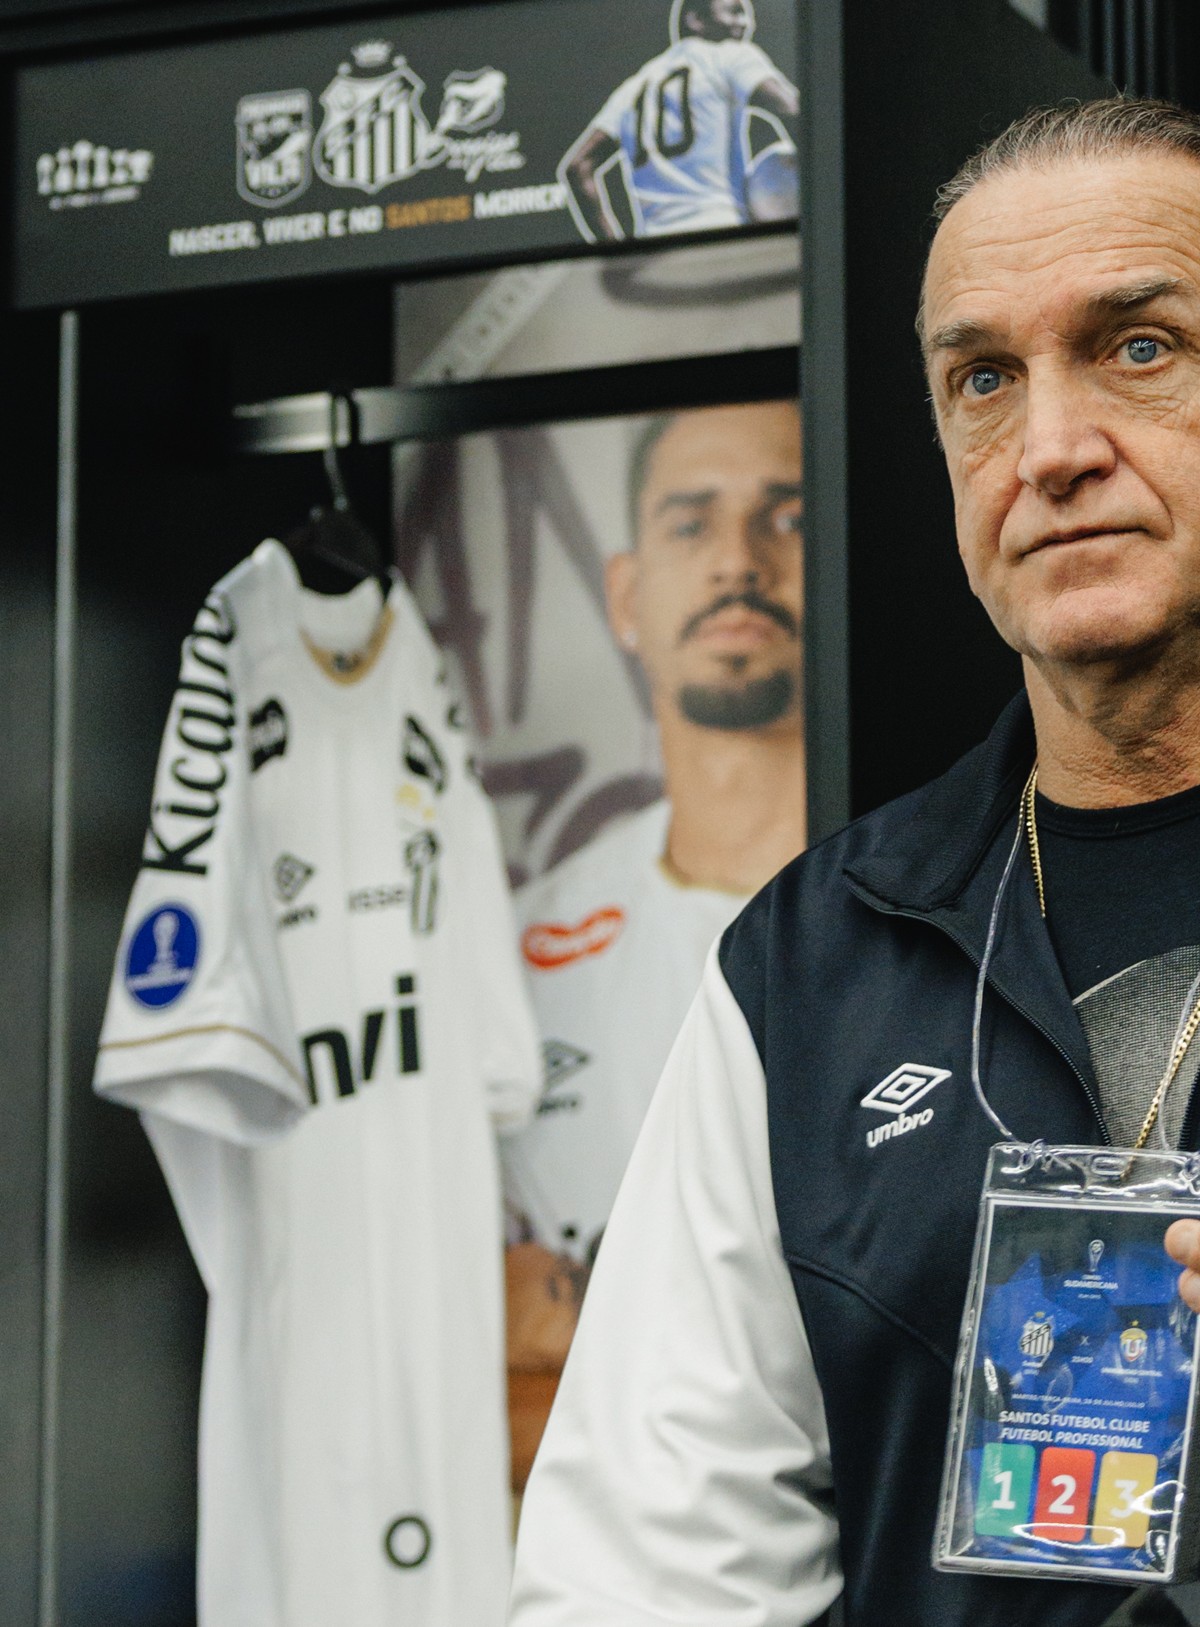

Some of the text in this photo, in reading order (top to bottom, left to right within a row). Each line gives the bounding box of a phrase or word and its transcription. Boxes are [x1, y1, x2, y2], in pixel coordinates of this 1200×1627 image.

[633, 66, 696, 170] 10
[168, 220, 260, 256] NASCER,
[262, 211, 326, 245] VIVER
[326, 208, 348, 238] E
[349, 205, 384, 235] NO
[385, 194, 472, 230] SANTOS
[866, 1108, 934, 1148] umbro
[1063, 1279, 1119, 1290] SUDAMERICANA
[999, 1410, 1150, 1433] SANTOS FUTEBOL CLUBE
[1000, 1427, 1143, 1449] FUTEBOL PROFISSIONAL
[992, 1470, 1138, 1519] 1 2 3
